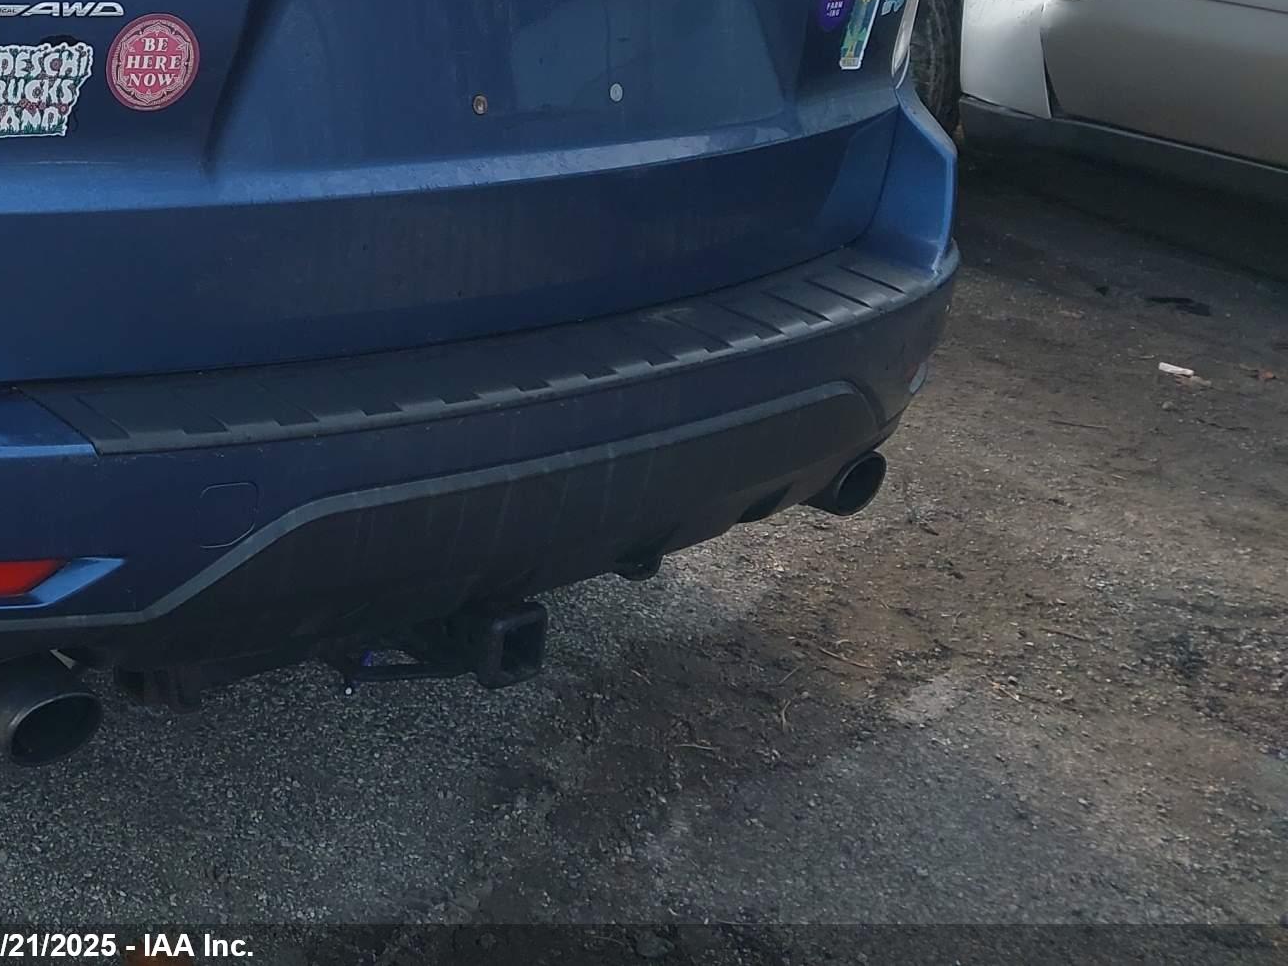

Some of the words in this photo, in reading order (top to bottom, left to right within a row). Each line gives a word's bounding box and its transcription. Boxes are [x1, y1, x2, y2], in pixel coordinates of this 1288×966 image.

[20, 1, 125, 17] AWD
[141, 37, 168, 52] BE
[125, 55, 182, 72] HERE
[127, 73, 176, 87] NOW
